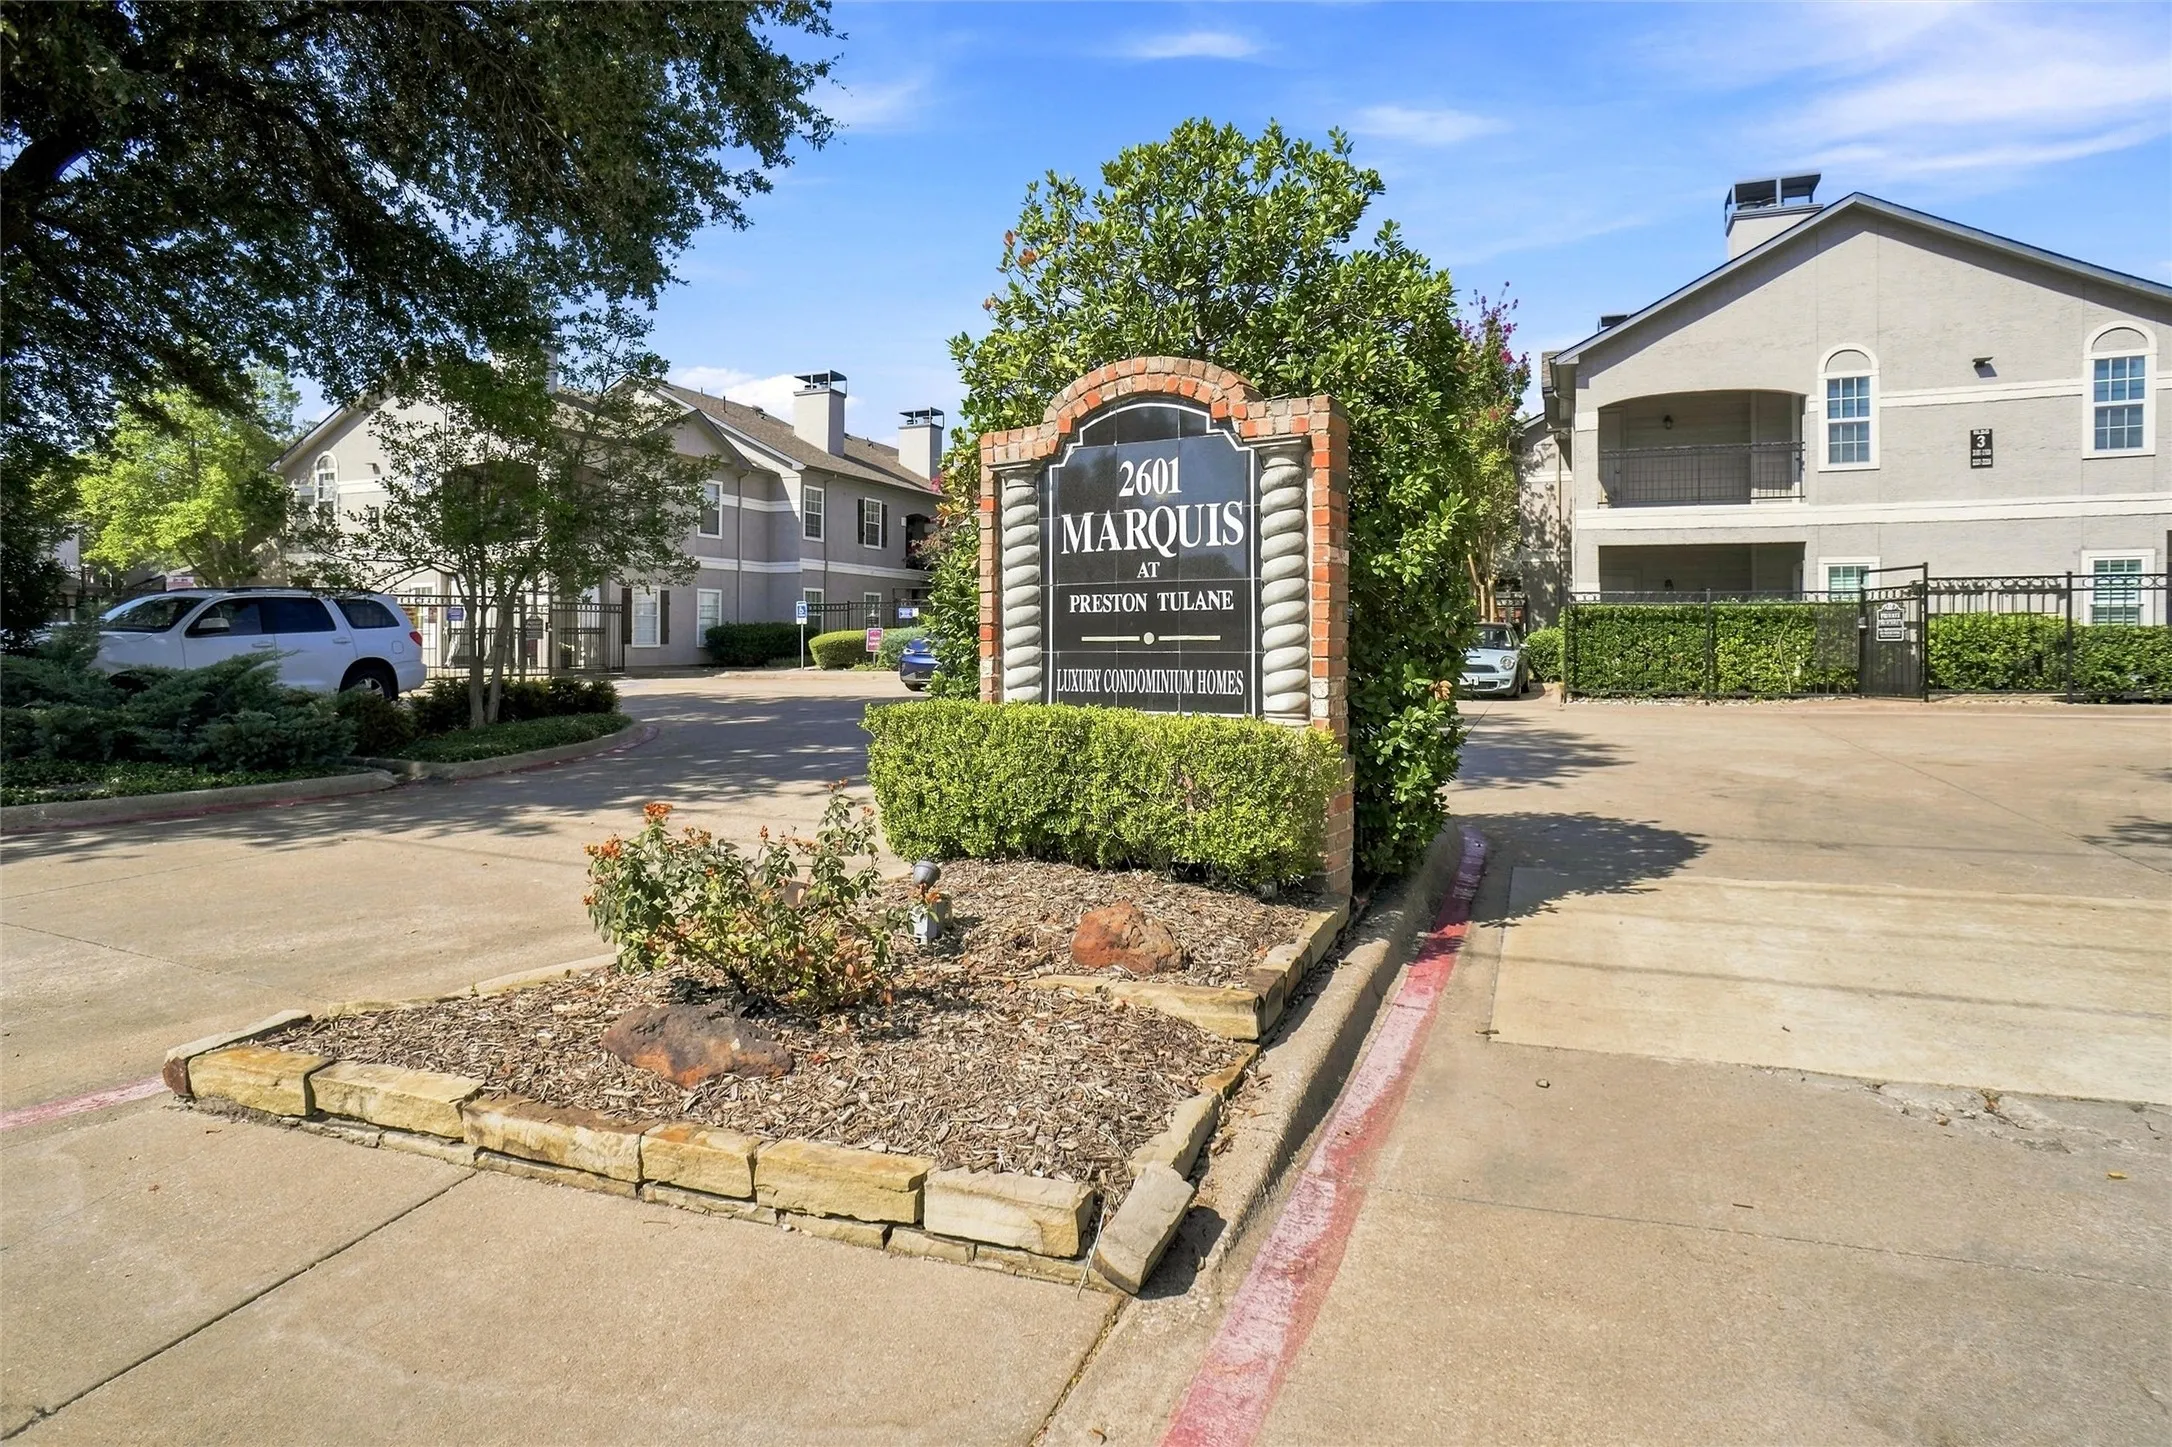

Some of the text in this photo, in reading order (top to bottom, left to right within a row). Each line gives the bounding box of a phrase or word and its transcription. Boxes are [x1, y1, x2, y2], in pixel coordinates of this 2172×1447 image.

[1976, 435, 1986, 448] 3
[1118, 456, 1182, 497] 2601
[1060, 500, 1245, 558] MARQUIS
[1136, 561, 1160, 578] AT
[1069, 590, 1235, 613] PRESTON TULANE
[1056, 668, 1244, 696] LUXURY CONDOMINIUM HOMES
